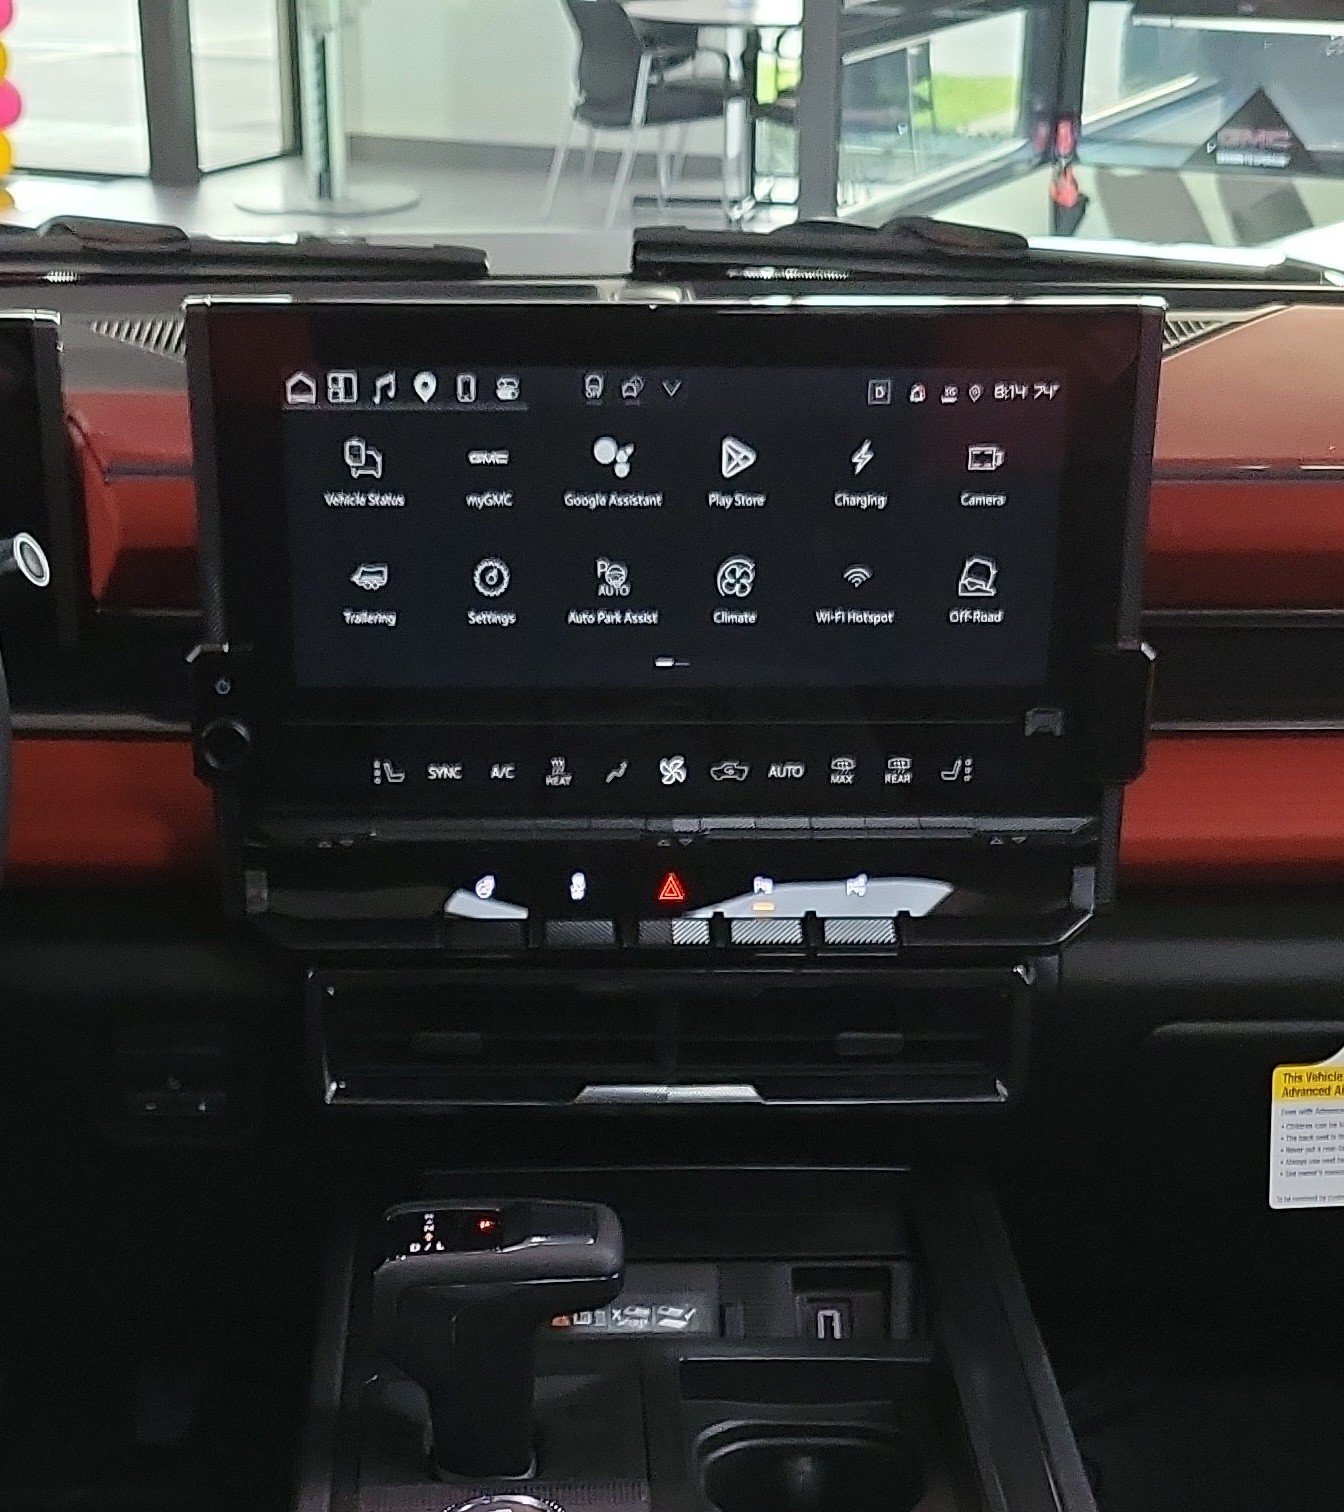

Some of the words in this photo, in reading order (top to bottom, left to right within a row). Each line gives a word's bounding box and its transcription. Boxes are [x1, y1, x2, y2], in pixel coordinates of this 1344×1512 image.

[323, 493, 366, 507] Vehicle
[367, 493, 405, 507] Status
[466, 493, 513, 509] myGMC
[564, 493, 607, 509] Google
[608, 493, 663, 507] Assistant
[708, 493, 733, 509] Play
[734, 493, 766, 507] Store
[834, 493, 887, 509] Charging
[960, 493, 1006, 507] Camera
[597, 584, 630, 598] AUTO
[343, 610, 396, 627] Trailering
[467, 610, 516, 627] Settings
[568, 610, 594, 625] Auto
[596, 610, 622, 625] Park
[623, 610, 659, 625] Assist
[713, 610, 757, 625] Climate
[816, 610, 846, 624] Wi-Fi
[848, 610, 894, 627] Hotspot
[949, 610, 1004, 625] Off-Road
[427, 762, 463, 781] SYNC
[490, 763, 516, 780] A/C
[767, 763, 805, 780] AUTO
[831, 773, 854, 785] MAX
[885, 772, 913, 784] REAR
[545, 773, 571, 787] HEAT
[1283, 1072, 1303, 1083] This
[1306, 1072, 1343, 1083] Vehicle
[1282, 1086, 1331, 1097] Advanced
